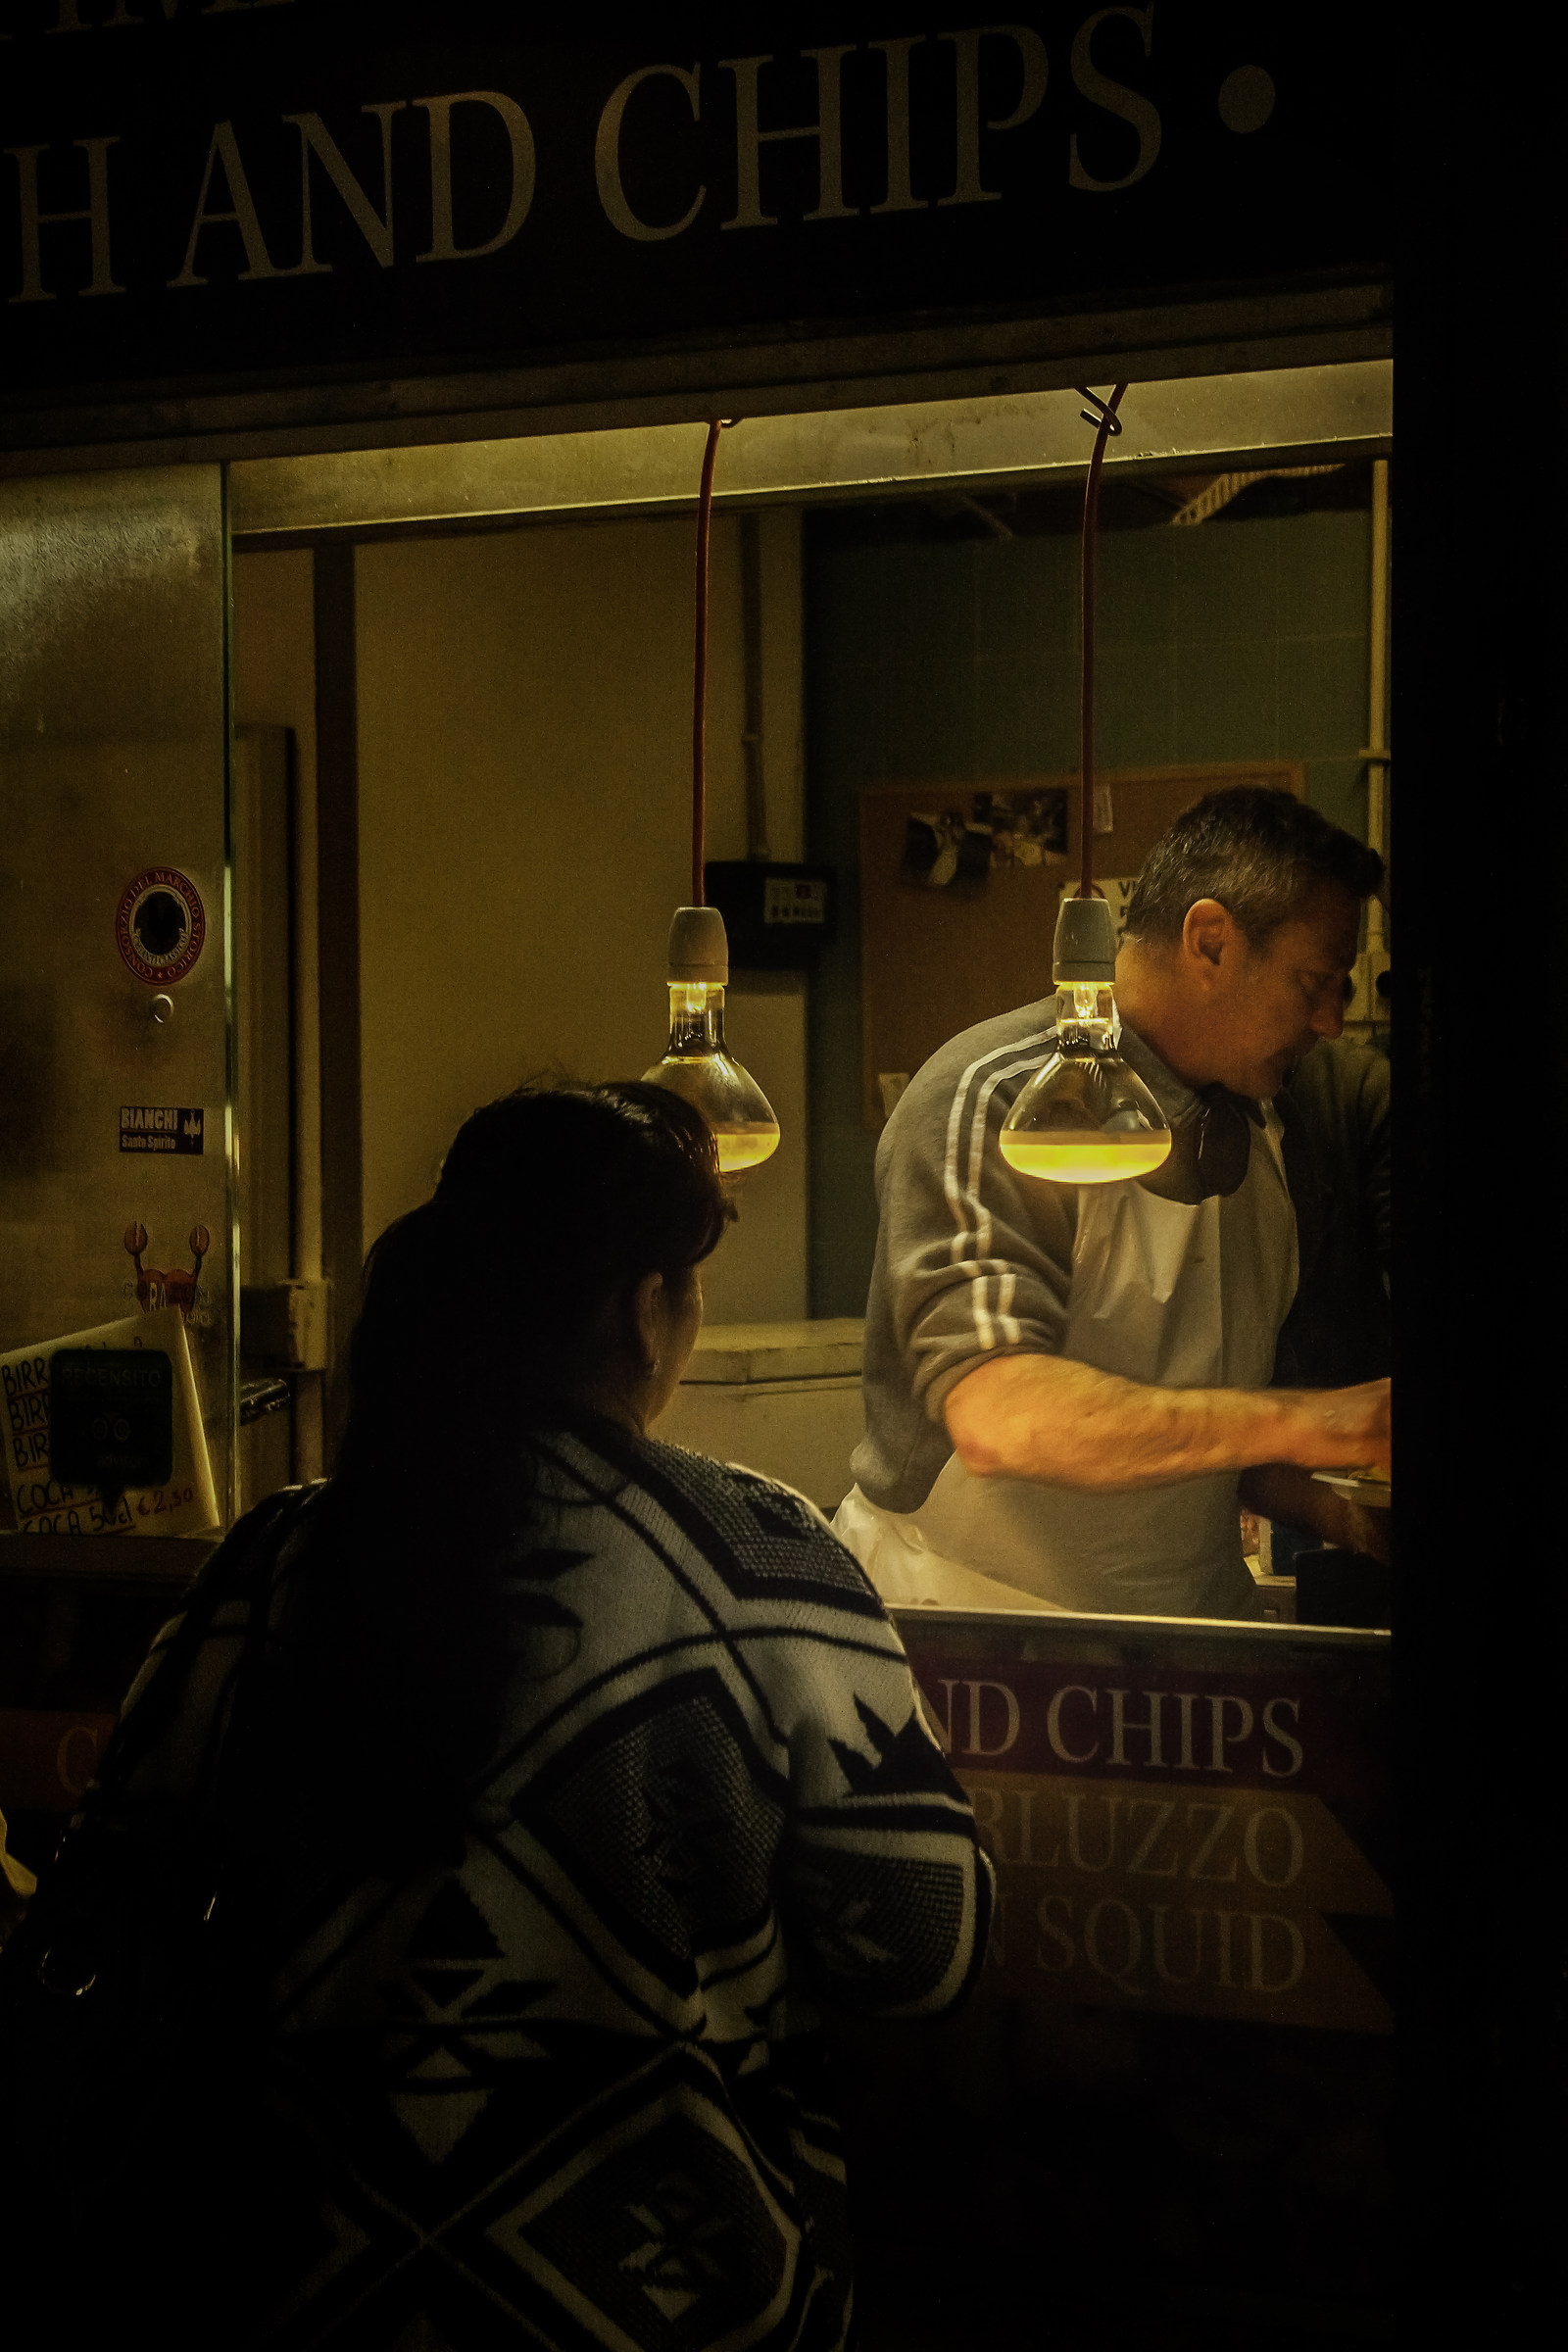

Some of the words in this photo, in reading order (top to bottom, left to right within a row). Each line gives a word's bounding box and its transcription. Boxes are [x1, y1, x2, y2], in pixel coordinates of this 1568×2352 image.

[167, 89, 537, 290] AND
[593, 1, 1164, 243] CHIPS
[154, 871, 200, 917] MARCHIO
[167, 923, 201, 978] STORICO
[121, 1107, 178, 1130] BIANCHI
[122, 1134, 146, 1149] Santo
[147, 1134, 176, 1152] Spirito
[62, 1367, 162, 1388] RECENSITO
[17, 1477, 74, 1515] COCA
[24, 1509, 81, 1537] COCA
[136, 1487, 194, 1516] €2,50
[1045, 1684, 1305, 1780] CHIPS
[1037, 1893, 1307, 1996] SQUID
